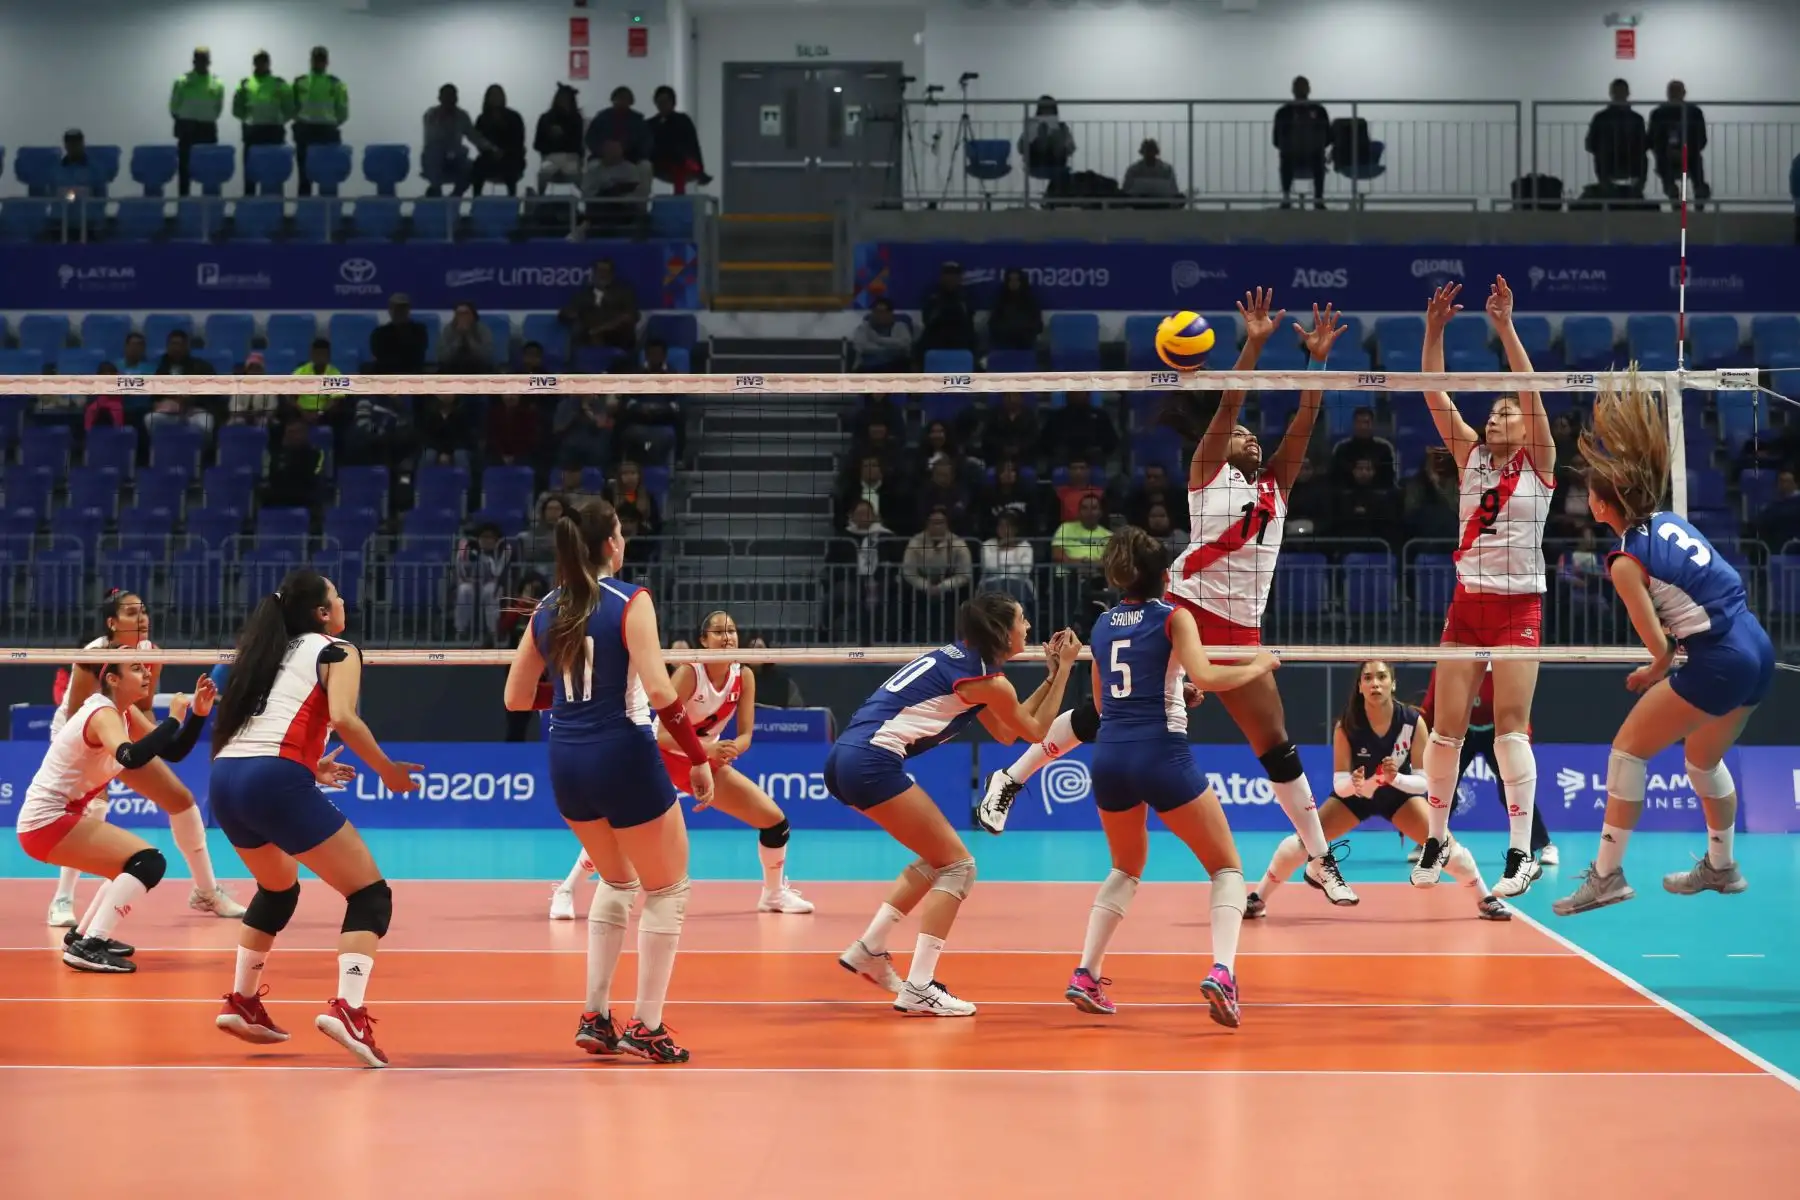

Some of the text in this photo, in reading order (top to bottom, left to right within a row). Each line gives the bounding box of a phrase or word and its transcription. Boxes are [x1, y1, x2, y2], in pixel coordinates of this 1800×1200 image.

[77, 267, 136, 279] LATAM
[1411, 259, 1465, 278] GLORIA
[1548, 269, 1606, 280] LATAM
[335, 285, 383, 295] TOYOTA
[117, 377, 145, 387] FIVB
[322, 377, 350, 387] FIVB
[529, 376, 557, 386] FIVB
[735, 376, 764, 386] FIVB
[943, 375, 971, 385] FIVB
[1150, 373, 1179, 383] FIVB
[1358, 374, 1386, 384] FIVB
[1566, 374, 1594, 384] FIVB
[1480, 488, 1500, 527] 9
[1241, 501, 1271, 545] 11
[1657, 522, 1711, 567] 3
[1110, 639, 1132, 699] 5
[695, 713, 718, 737] 2
